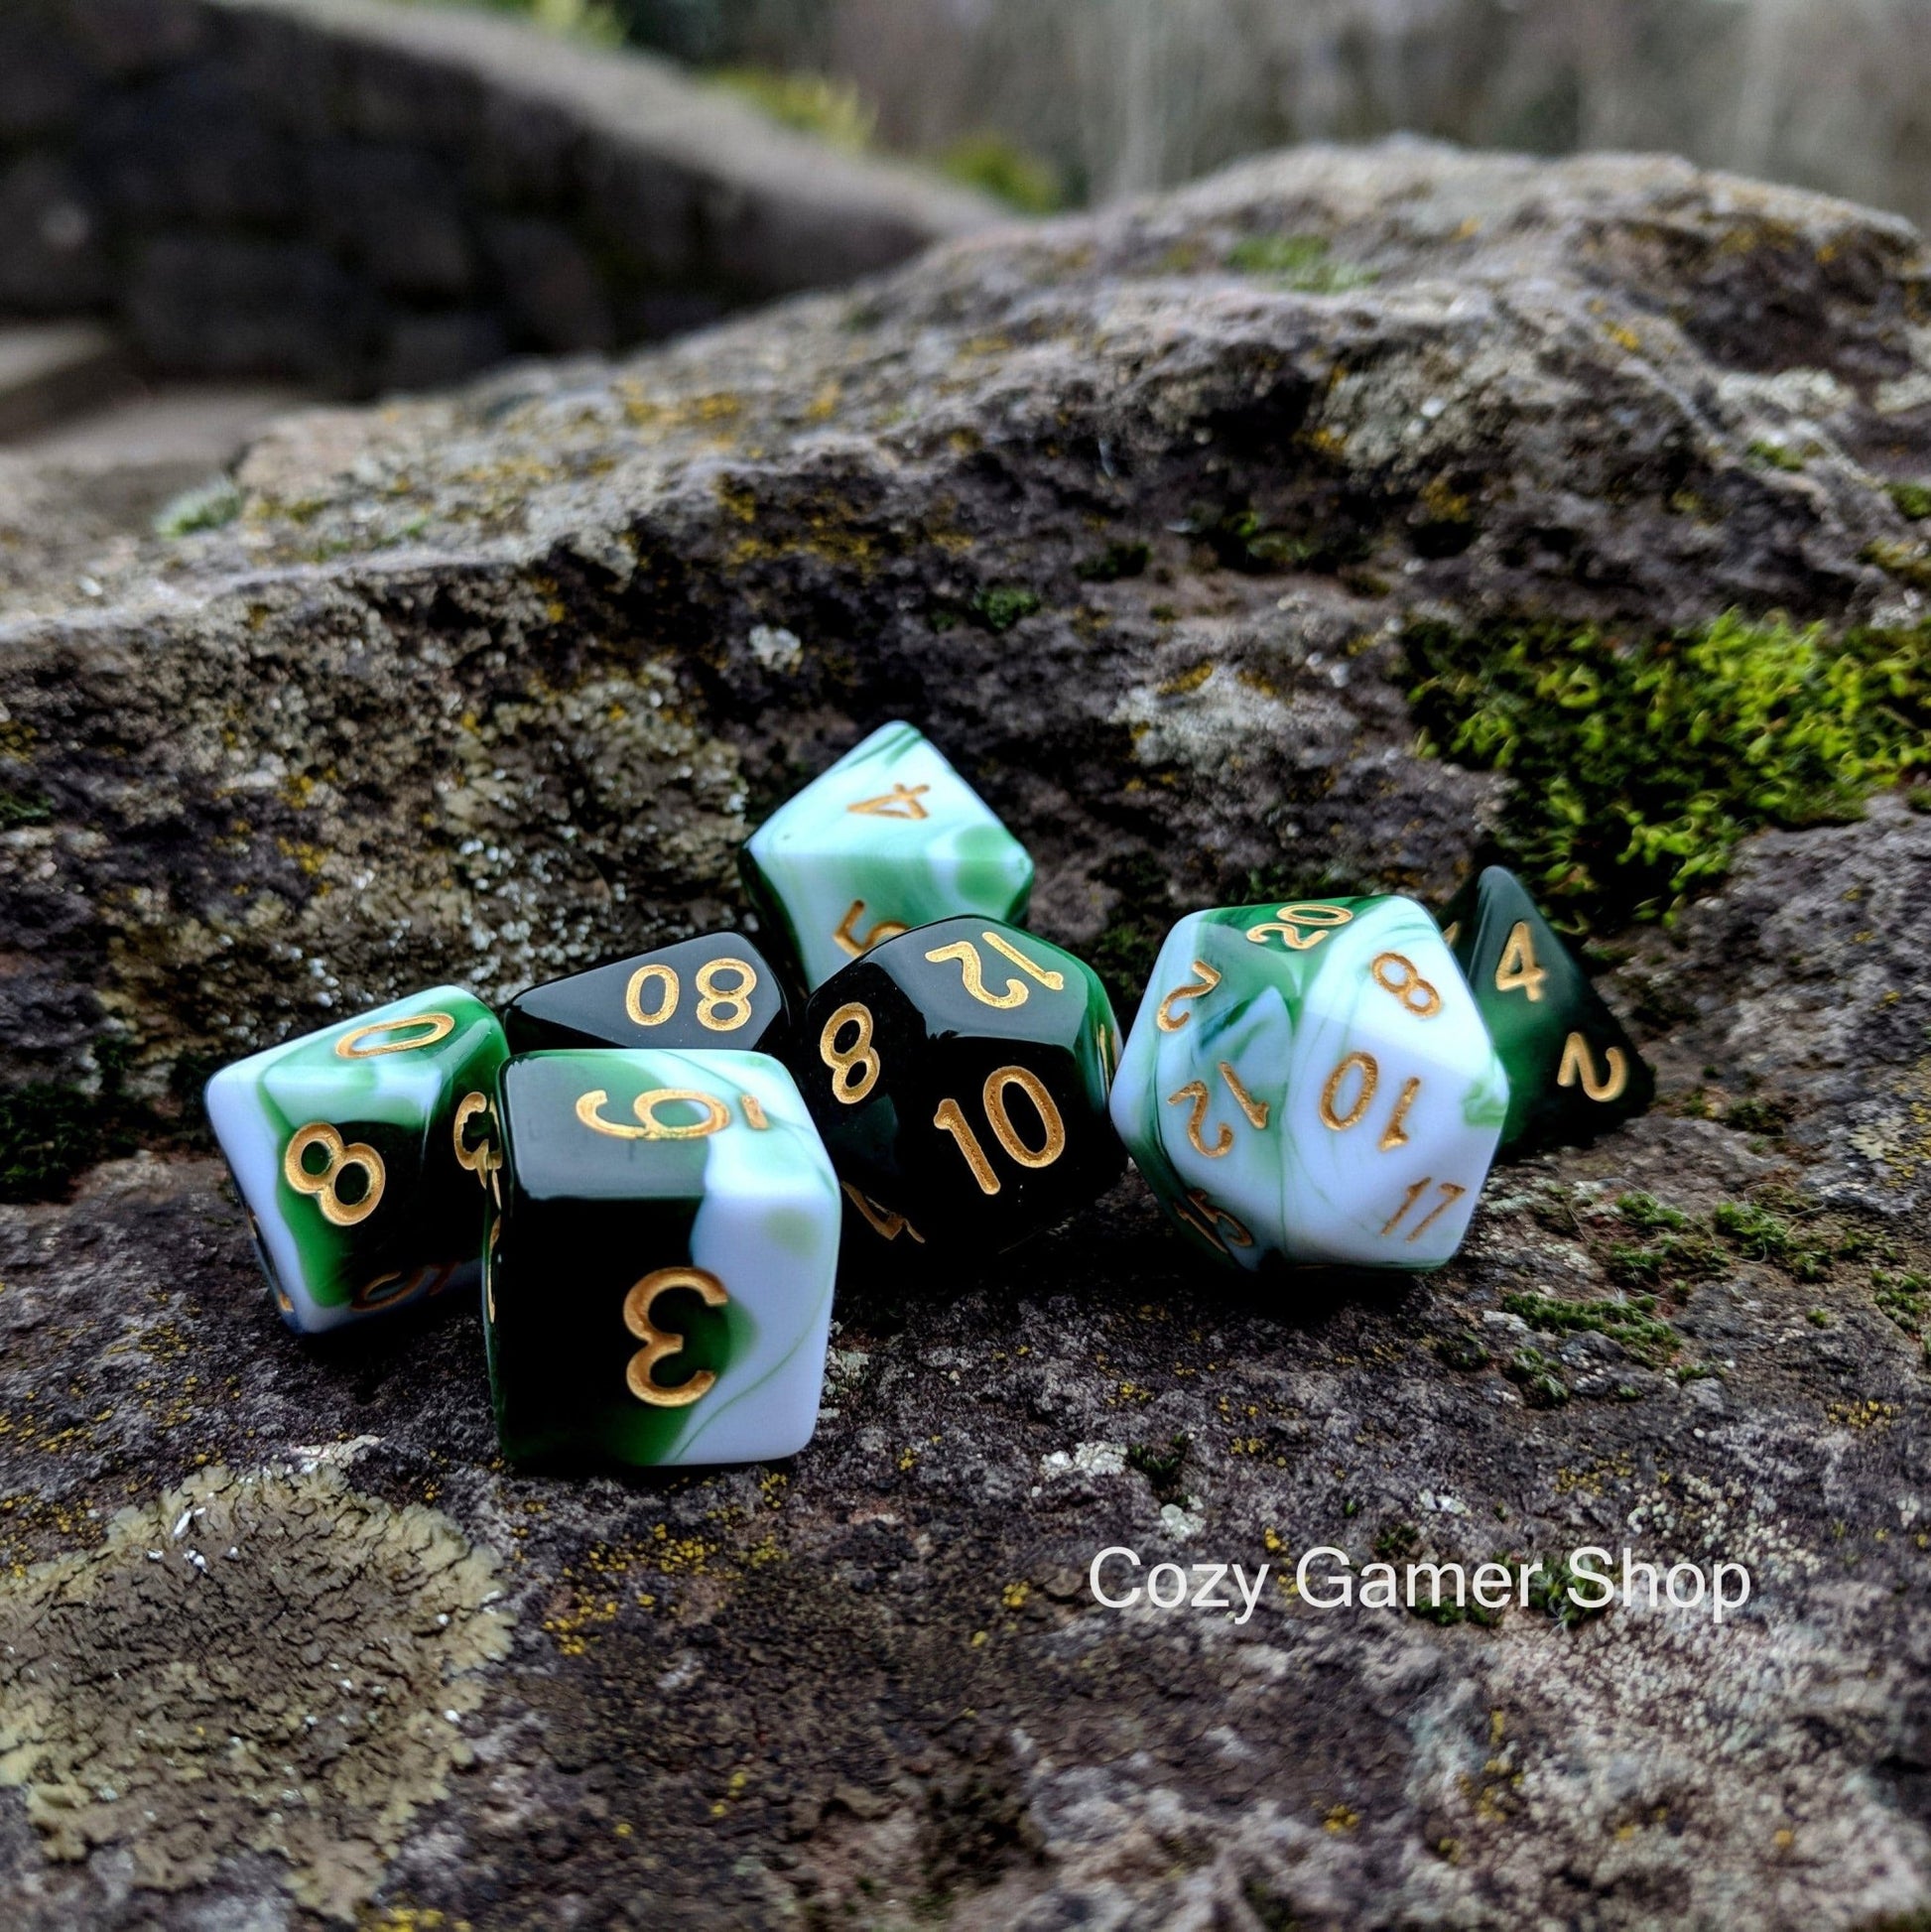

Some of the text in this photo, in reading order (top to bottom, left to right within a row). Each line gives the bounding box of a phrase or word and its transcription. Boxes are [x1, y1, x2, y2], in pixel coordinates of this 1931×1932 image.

[1246, 904, 1353, 950] 20
[1495, 921, 1548, 1002] 4
[925, 931, 1065, 1010] 12
[1156, 960, 1223, 1033] 2
[1369, 952, 1443, 1019] 8
[820, 1001, 881, 1105] 8
[1556, 1031, 1630, 1102] 2
[933, 1065, 1066, 1196] 10
[1167, 1061, 1271, 1159] 12
[284, 1121, 387, 1226] 8
[1380, 1177, 1468, 1243] 17
[622, 1266, 729, 1408] 3
